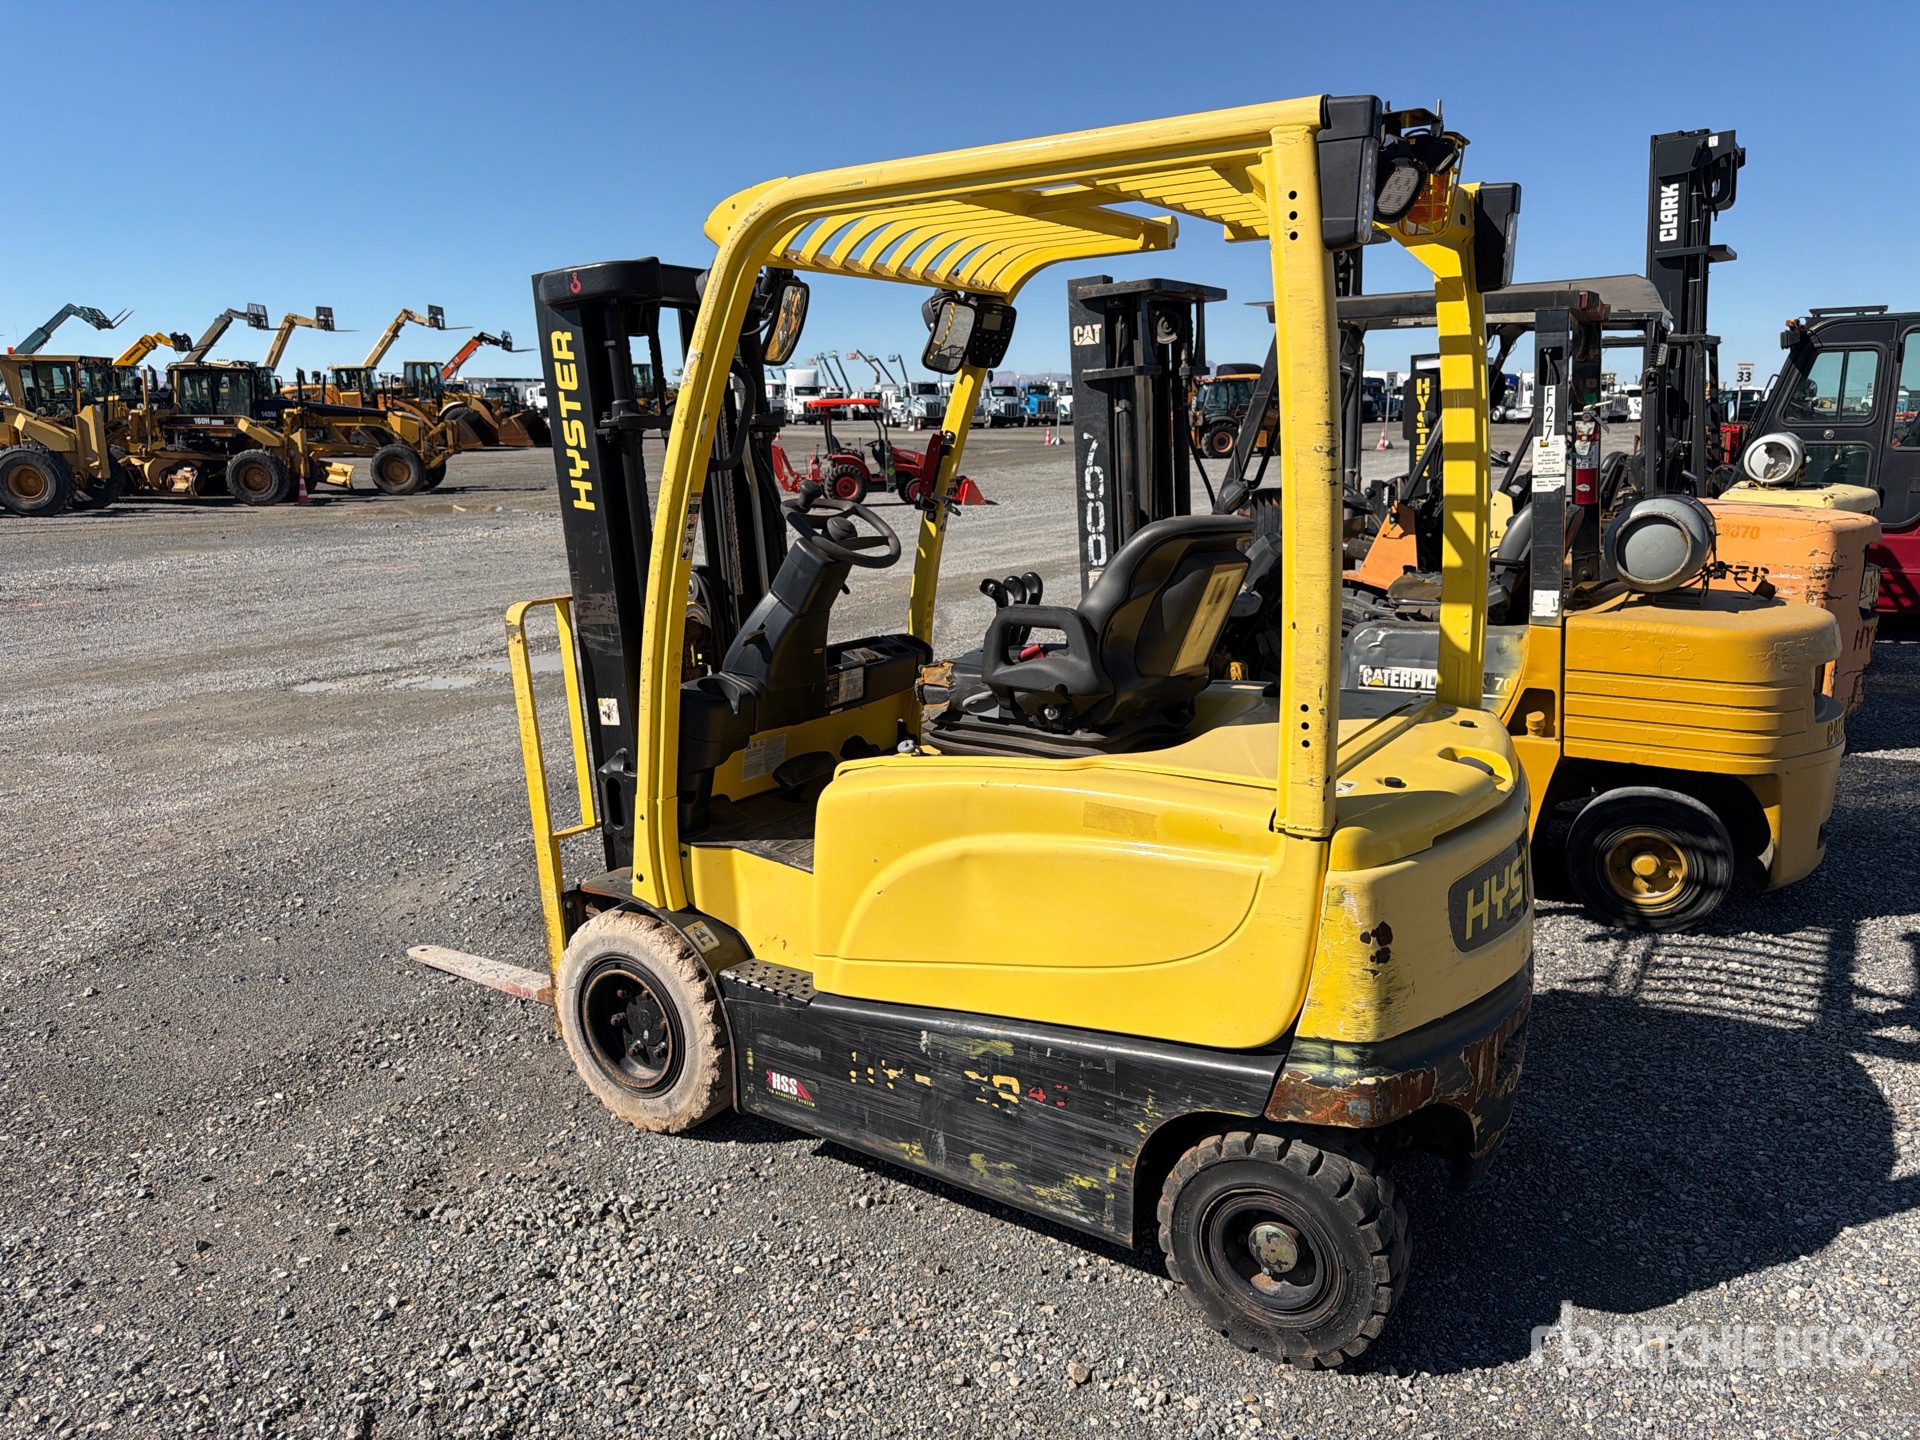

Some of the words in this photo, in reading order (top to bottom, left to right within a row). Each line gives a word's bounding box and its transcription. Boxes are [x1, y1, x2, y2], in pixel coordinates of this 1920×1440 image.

[1659, 183, 1679, 242] CLARK
[1073, 323, 1102, 346] CAT
[1389, 378, 1394, 387] 2
[1737, 371, 1752, 382] 33
[551, 330, 596, 511] HYSTER
[1082, 432, 1107, 567] 7000
[772, 1071, 798, 1096] HSS
